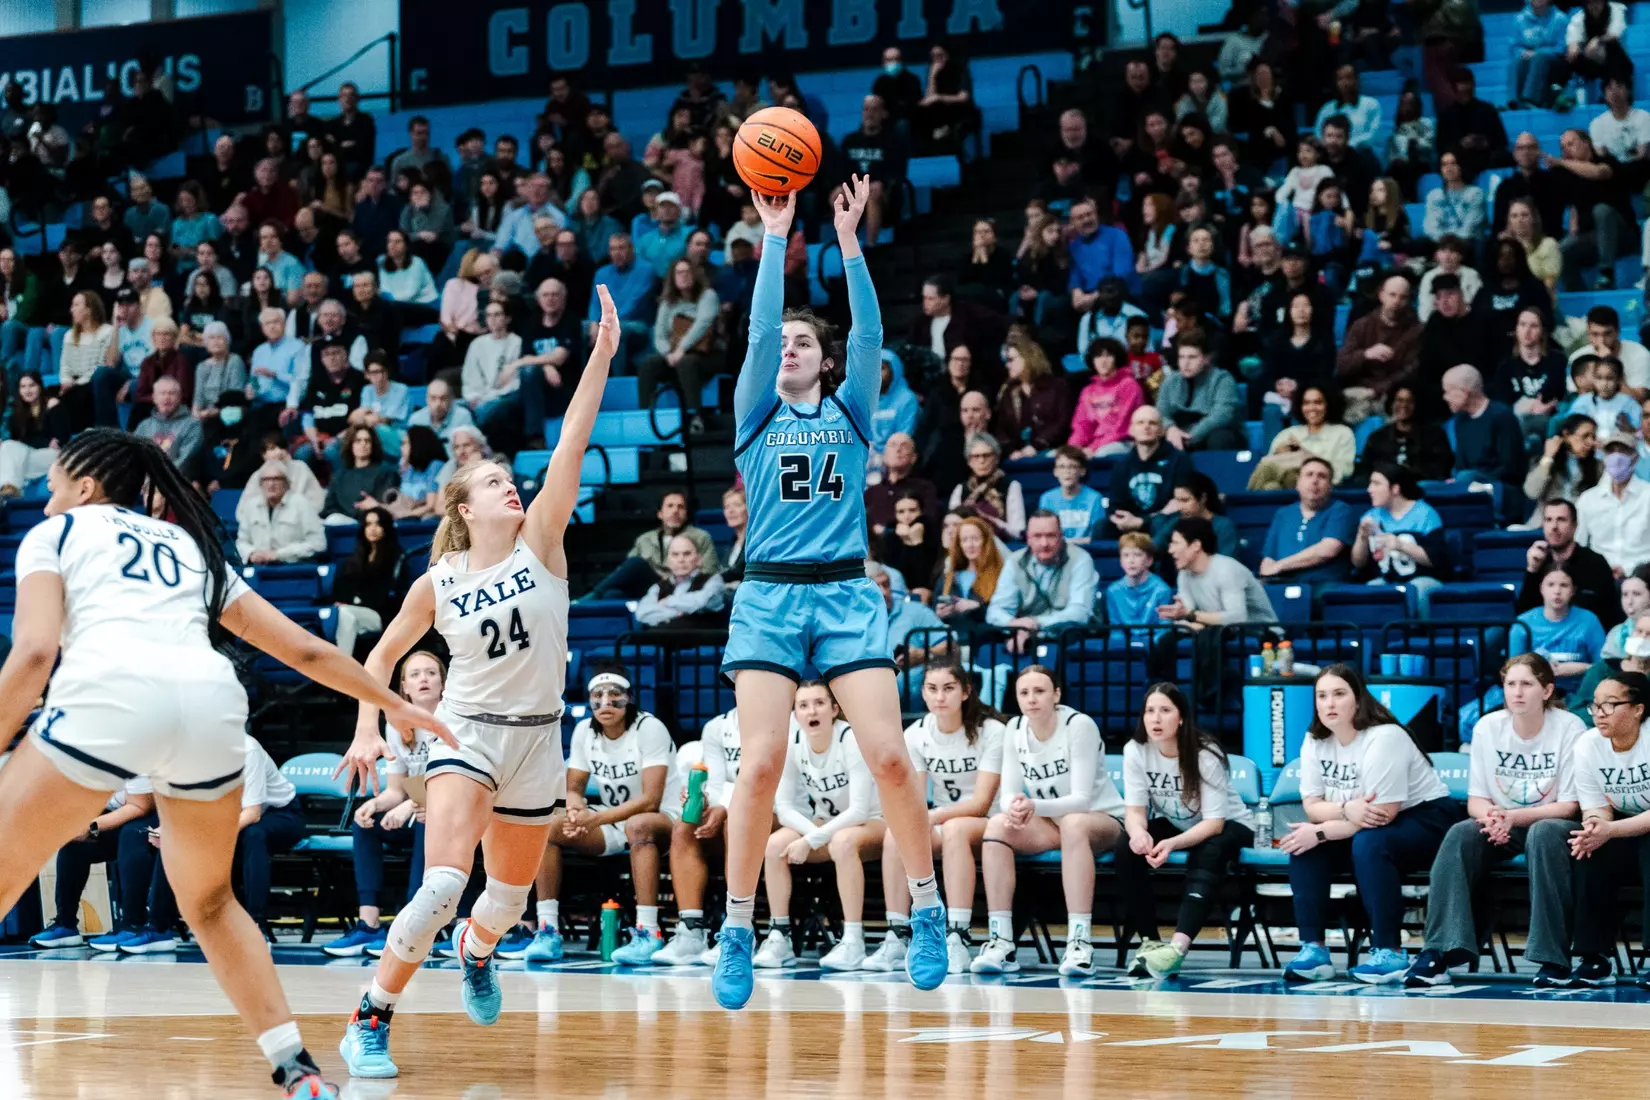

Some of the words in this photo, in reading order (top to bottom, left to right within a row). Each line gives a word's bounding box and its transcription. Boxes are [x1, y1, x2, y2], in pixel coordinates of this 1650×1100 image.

[488, 0, 1004, 76] COLUMBIA
[757, 131, 804, 165] ELITE
[766, 430, 854, 447] COLUMBIA
[779, 452, 844, 502] 24
[118, 531, 181, 588] 20
[450, 567, 536, 618] YALE
[480, 607, 530, 660] 24
[1271, 690, 1285, 765] POWERADE
[725, 747, 741, 762] YA
[923, 757, 978, 774] YALE
[1495, 750, 1556, 771] YALE
[282, 766, 336, 777] COLUMBI
[591, 759, 639, 780] YALE
[1020, 758, 1069, 781] YALE
[1146, 771, 1184, 791] YAL
[1494, 767, 1557, 779] BASKETBALL
[1599, 762, 1650, 785] YALE
[802, 771, 850, 793] YALE
[943, 779, 962, 802] 5
[604, 784, 631, 807] 22
